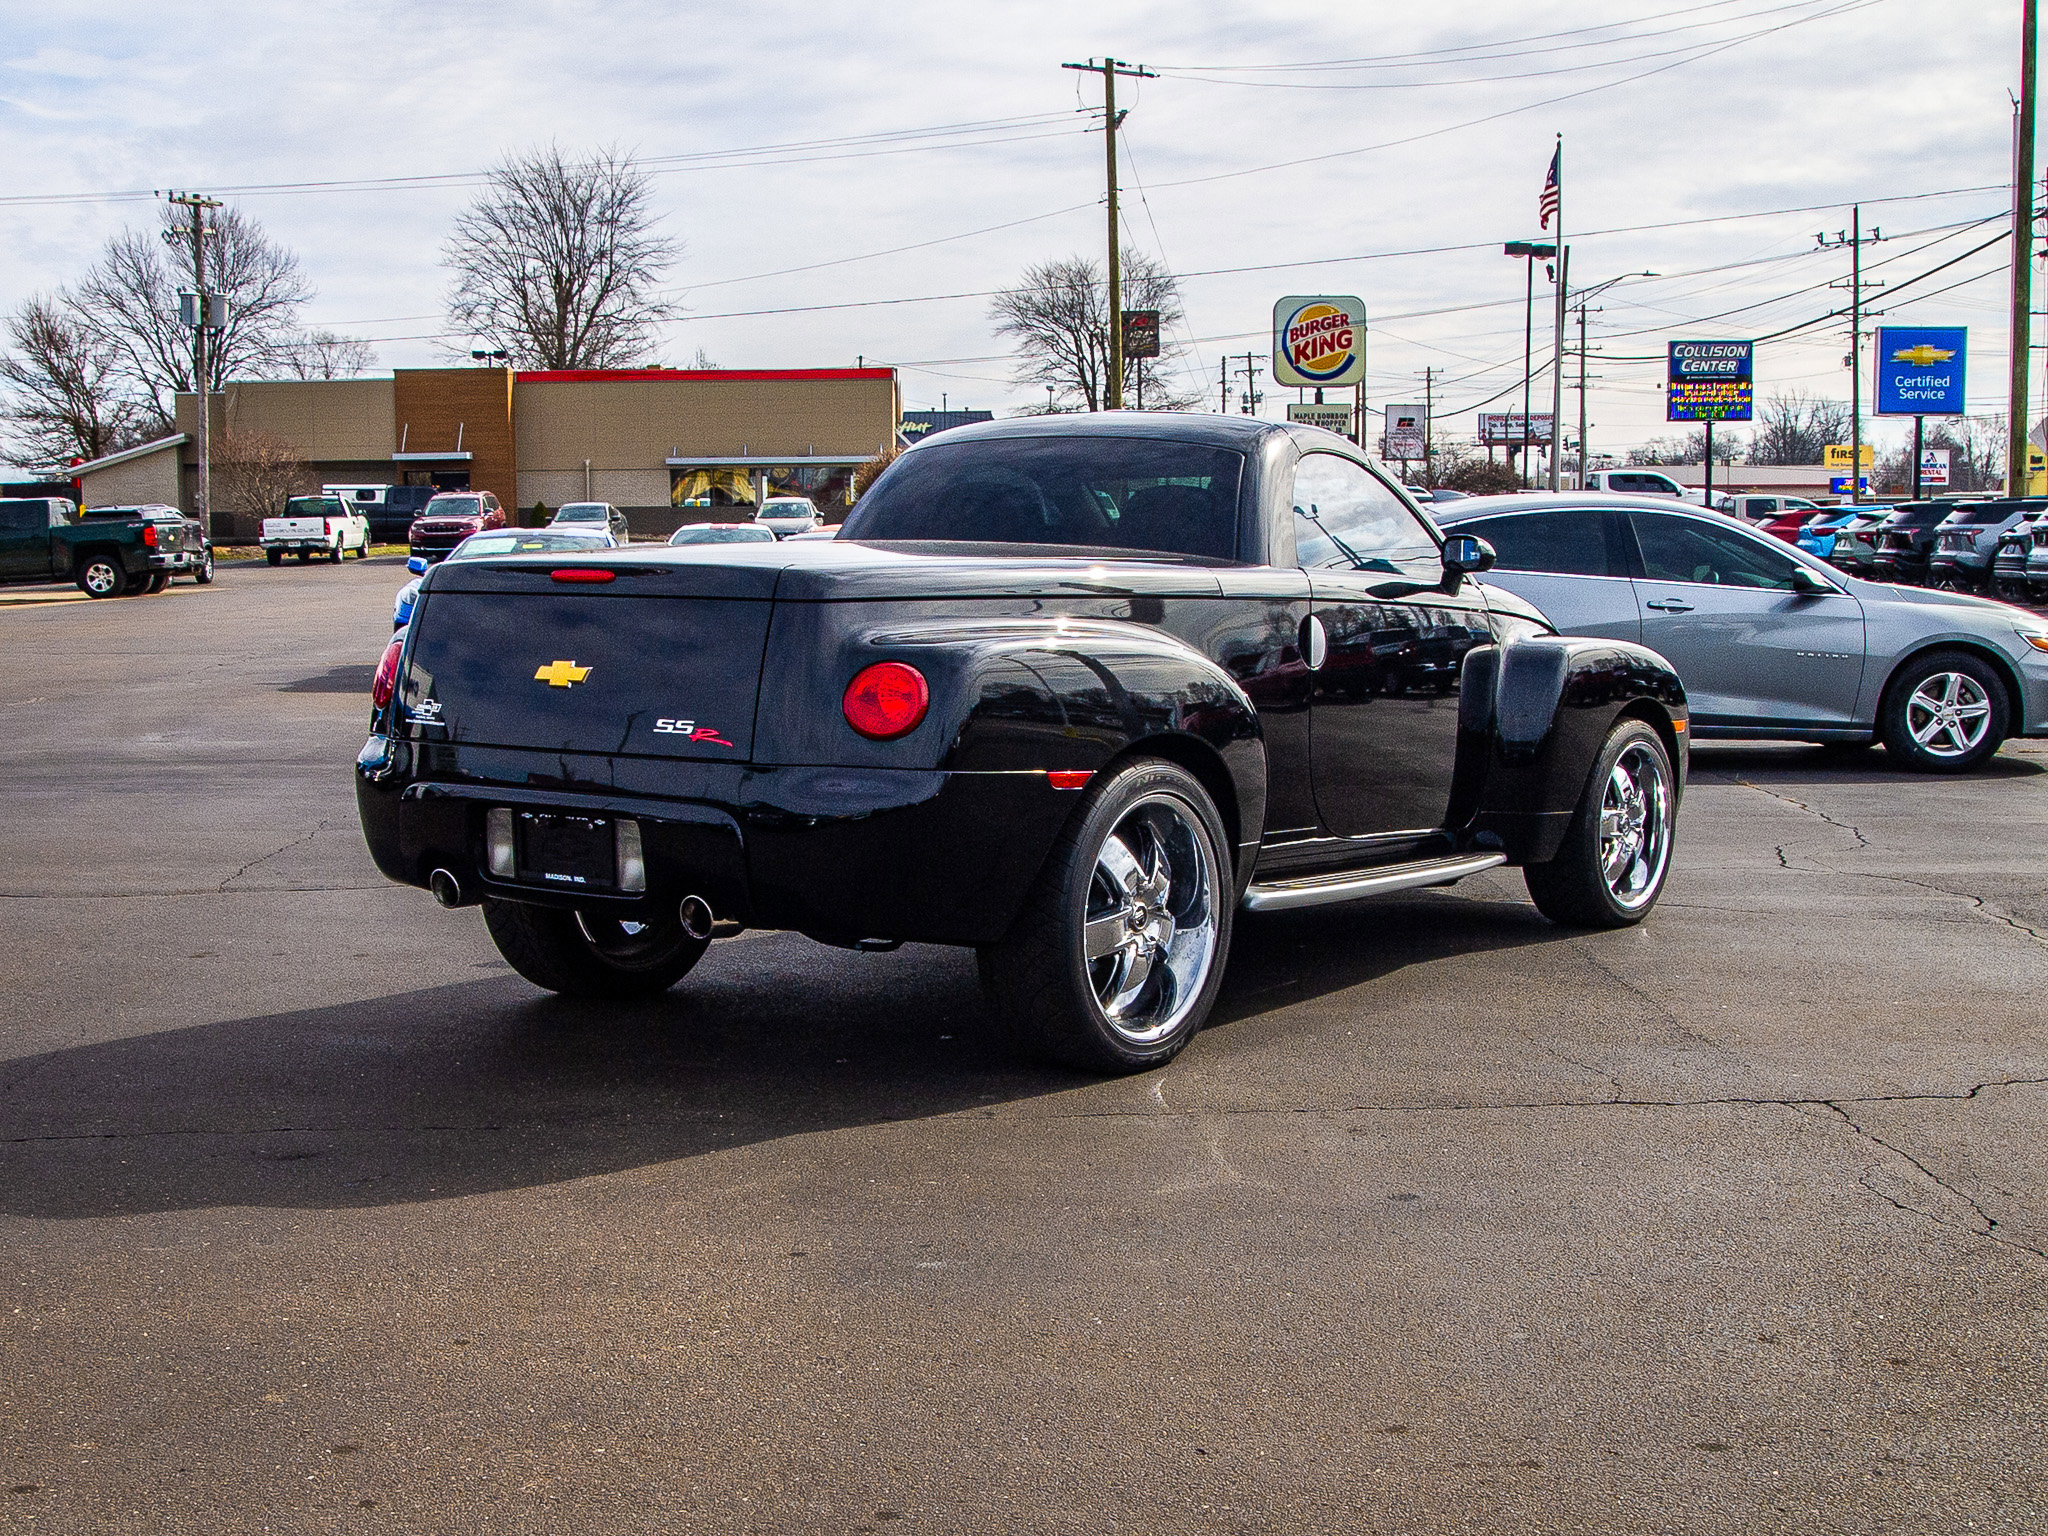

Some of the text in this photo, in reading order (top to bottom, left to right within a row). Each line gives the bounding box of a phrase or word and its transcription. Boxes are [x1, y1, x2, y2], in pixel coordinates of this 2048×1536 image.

[1289, 313, 1350, 343] BURGER
[1294, 329, 1353, 365] KING
[1673, 344, 1748, 358] COLLISION
[1680, 359, 1737, 373] CENTER
[1895, 375, 1950, 387] Certified
[1899, 388, 1946, 400] Service
[1293, 412, 1349, 420] MAPLE BOURBON
